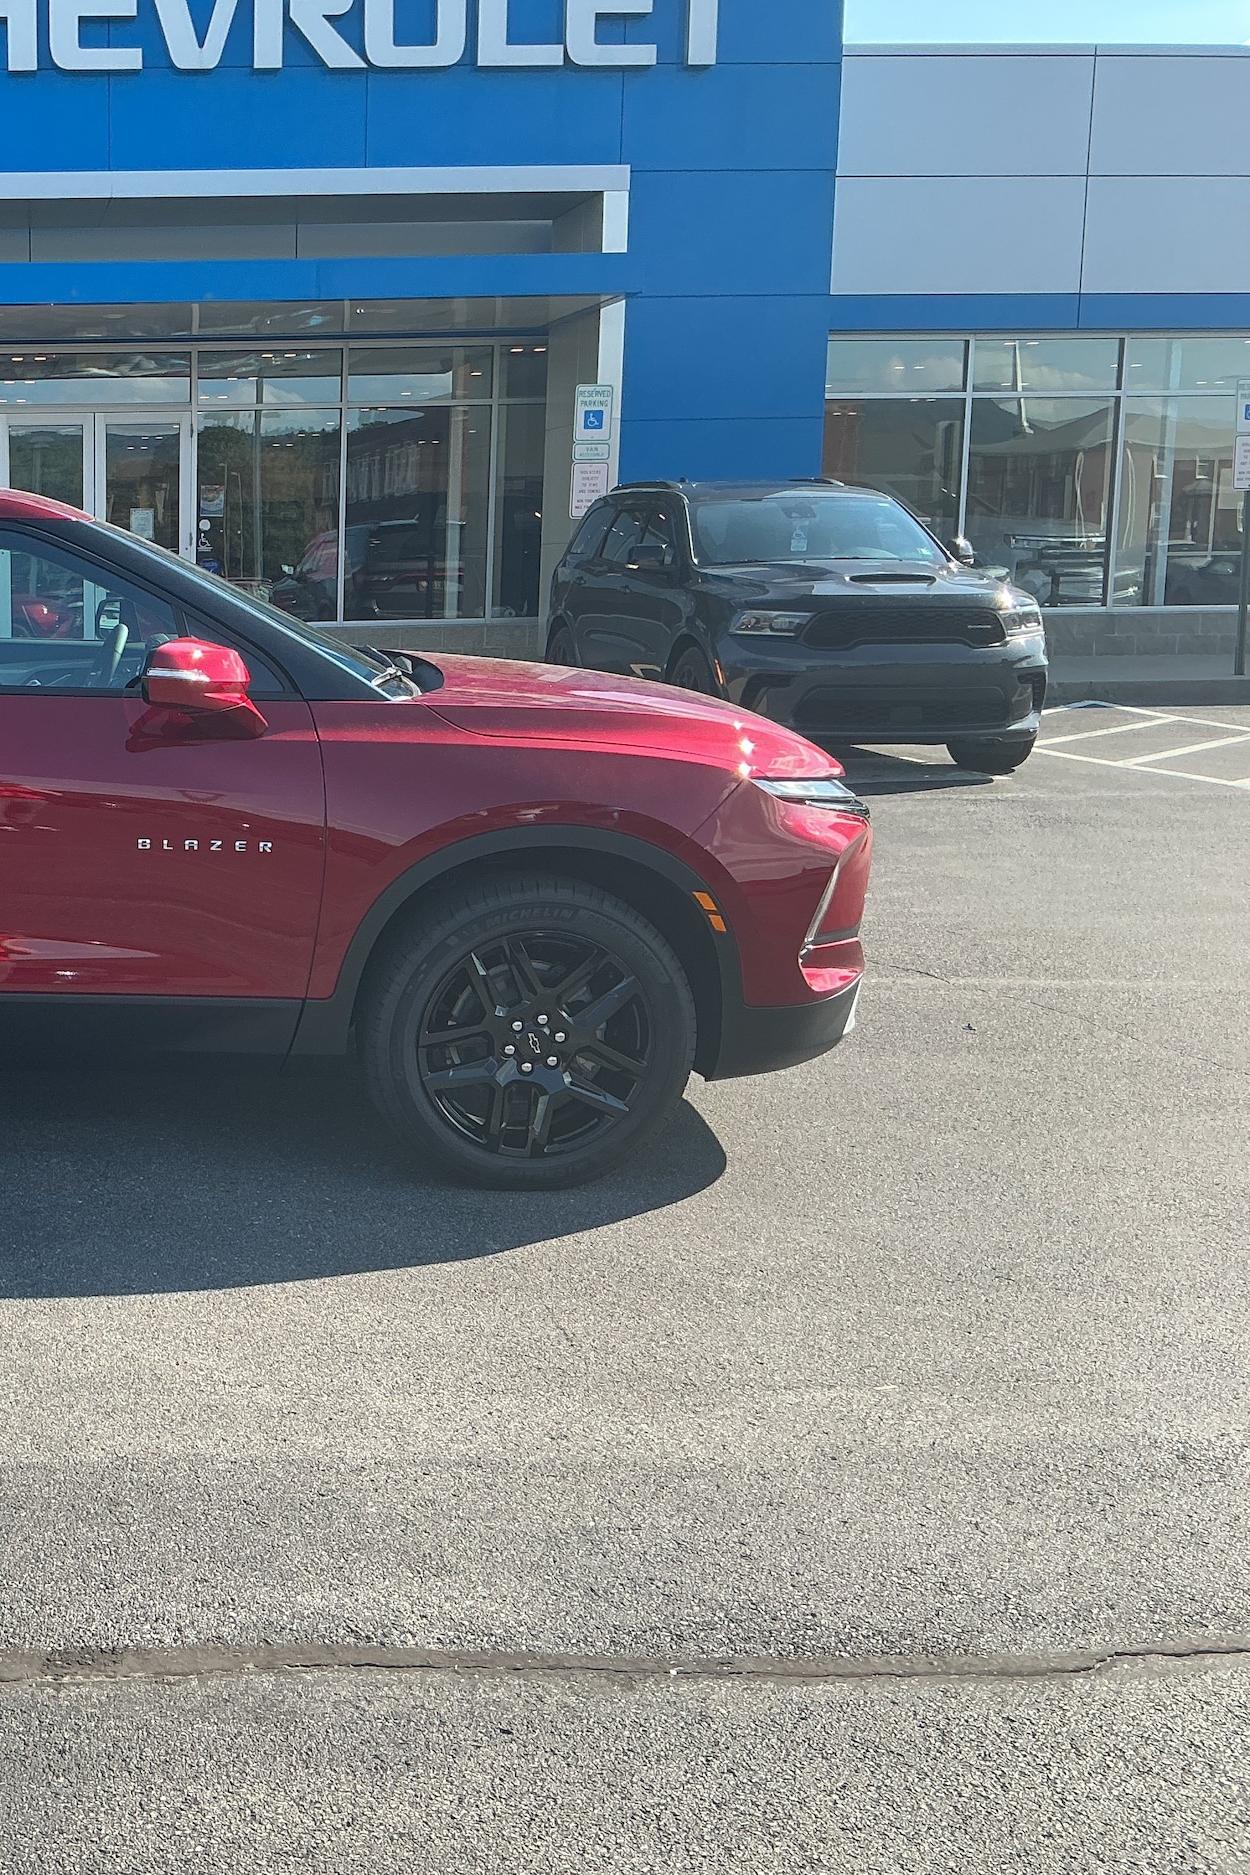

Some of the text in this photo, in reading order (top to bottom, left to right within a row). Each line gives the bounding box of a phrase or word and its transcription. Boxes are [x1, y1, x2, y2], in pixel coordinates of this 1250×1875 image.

[579, 390, 611, 398] RESERVED
[137, 838, 273, 853] BLAZER
[487, 907, 574, 924] MICHELIN
